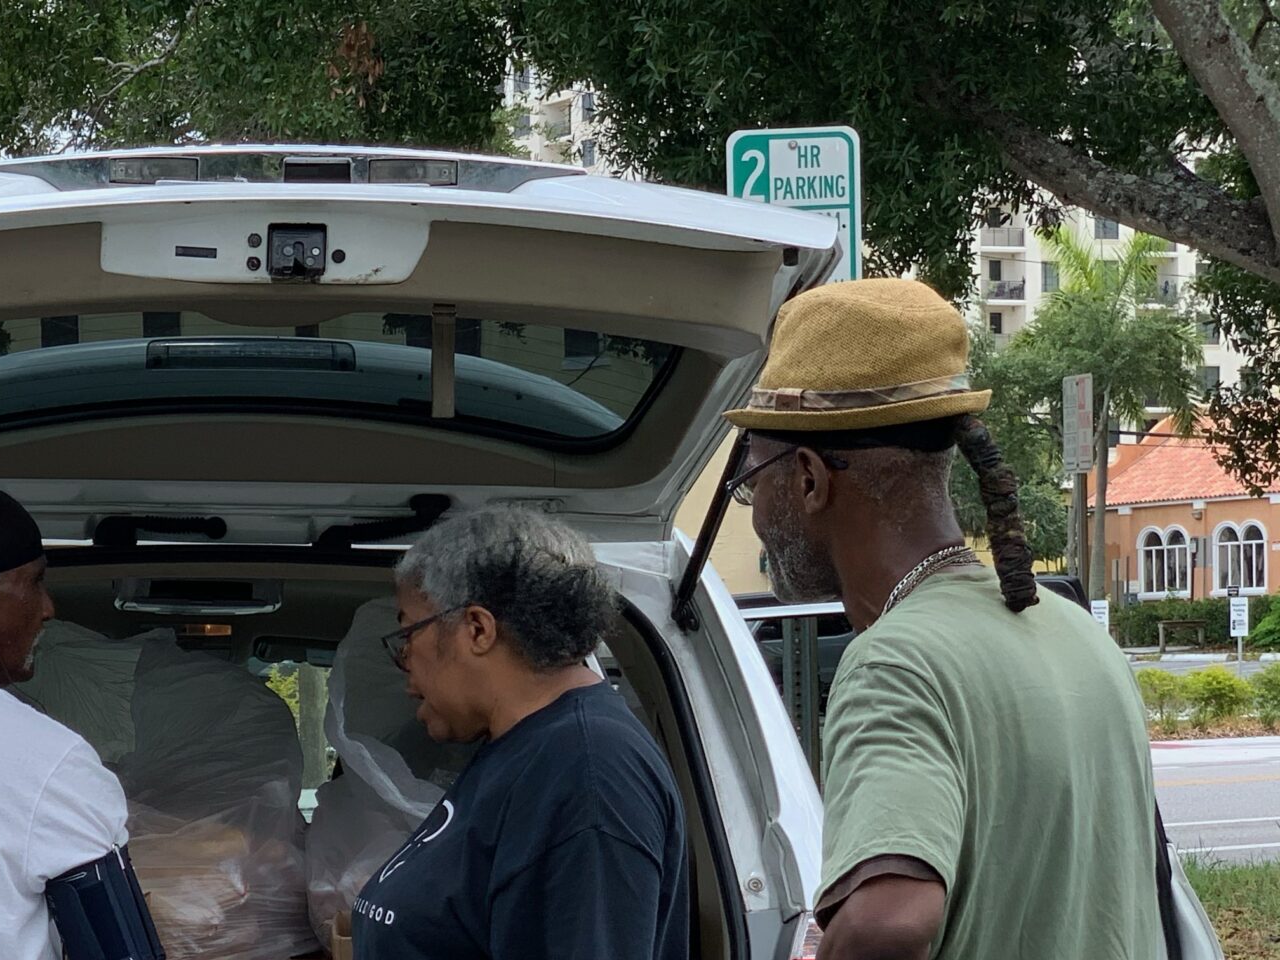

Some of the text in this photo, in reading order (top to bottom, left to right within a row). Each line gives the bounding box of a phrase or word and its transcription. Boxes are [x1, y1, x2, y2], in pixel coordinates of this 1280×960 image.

[741, 145, 821, 202] 2 HR
[774, 174, 846, 201] PARKING
[368, 904, 395, 925] GOD
